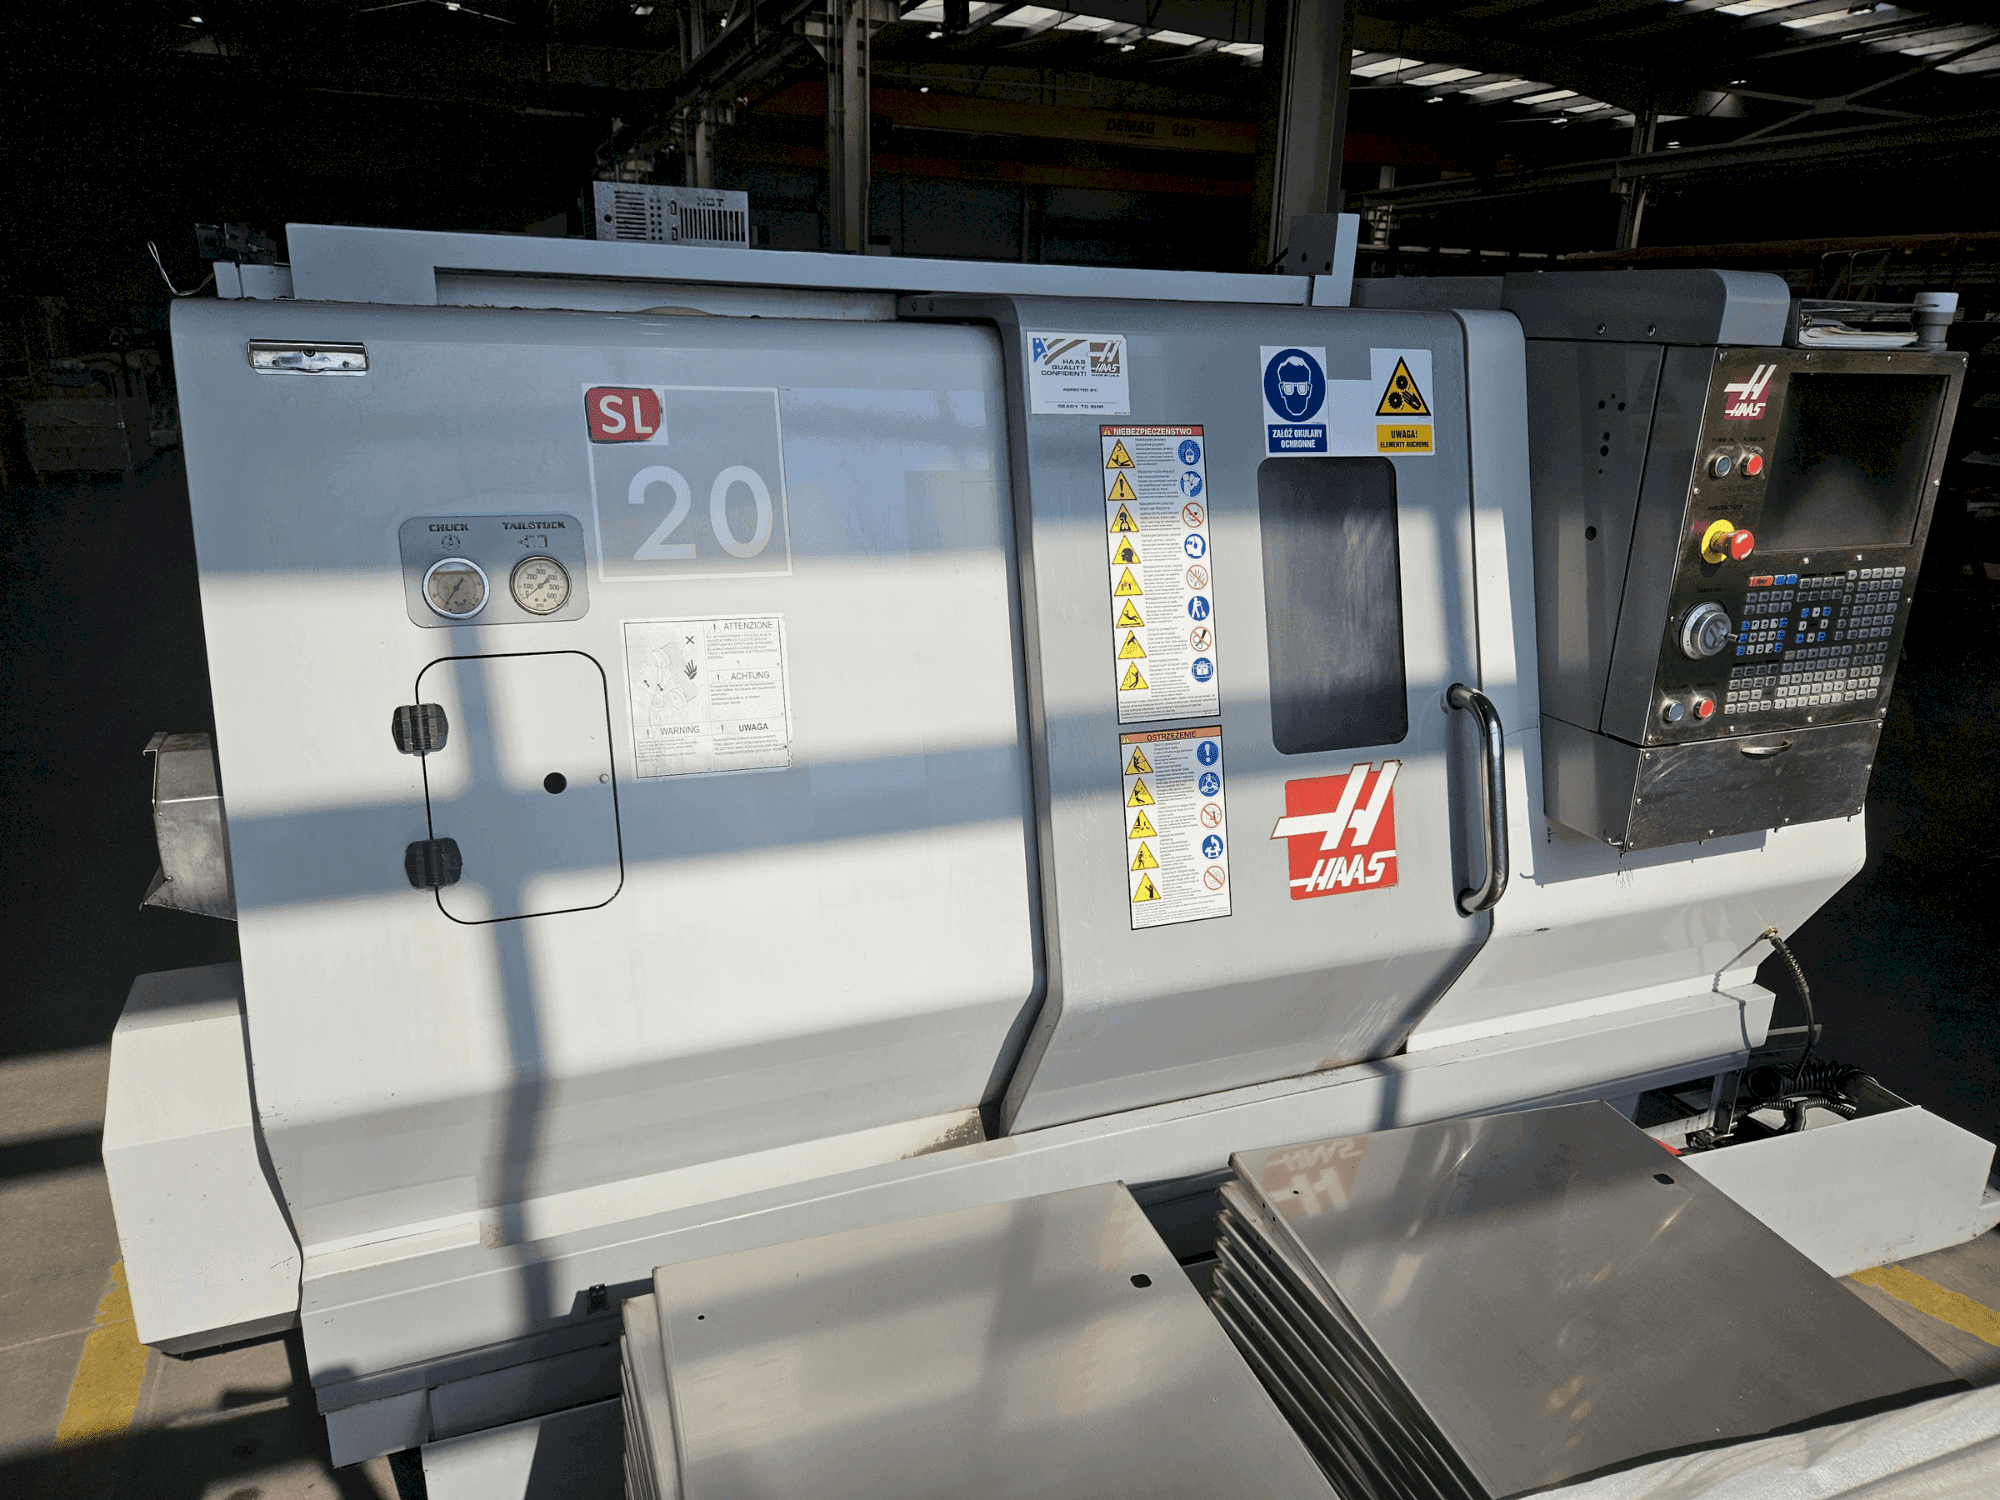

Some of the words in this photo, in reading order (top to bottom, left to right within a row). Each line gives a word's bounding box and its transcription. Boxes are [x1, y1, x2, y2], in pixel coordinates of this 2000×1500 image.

[1106, 118, 1156, 134] DEMAG
[1091, 364, 1120, 373] HAAS
[1725, 402, 1766, 417] HAAS
[599, 395, 652, 434] SL
[1113, 427, 1192, 435] NIEBEZPIECZEŃSTWO
[1272, 428, 1292, 438] ZAŁÓŻ
[1294, 429, 1322, 438] OKULARY
[1391, 430, 1418, 438] UWAGA!
[1280, 439, 1316, 448] OCHRONNE
[628, 465, 773, 561] 20
[428, 524, 470, 532] CHUCK
[502, 522, 566, 530] TAILSTOCK
[724, 621, 774, 630] ATTENZIONE
[731, 671, 770, 680] ACHTUNG
[660, 726, 700, 735] WARNING
[738, 722, 769, 732] UWAGA
[1146, 730, 1196, 741] OSTRZEŻENIE
[1290, 850, 1397, 892] HAAS
